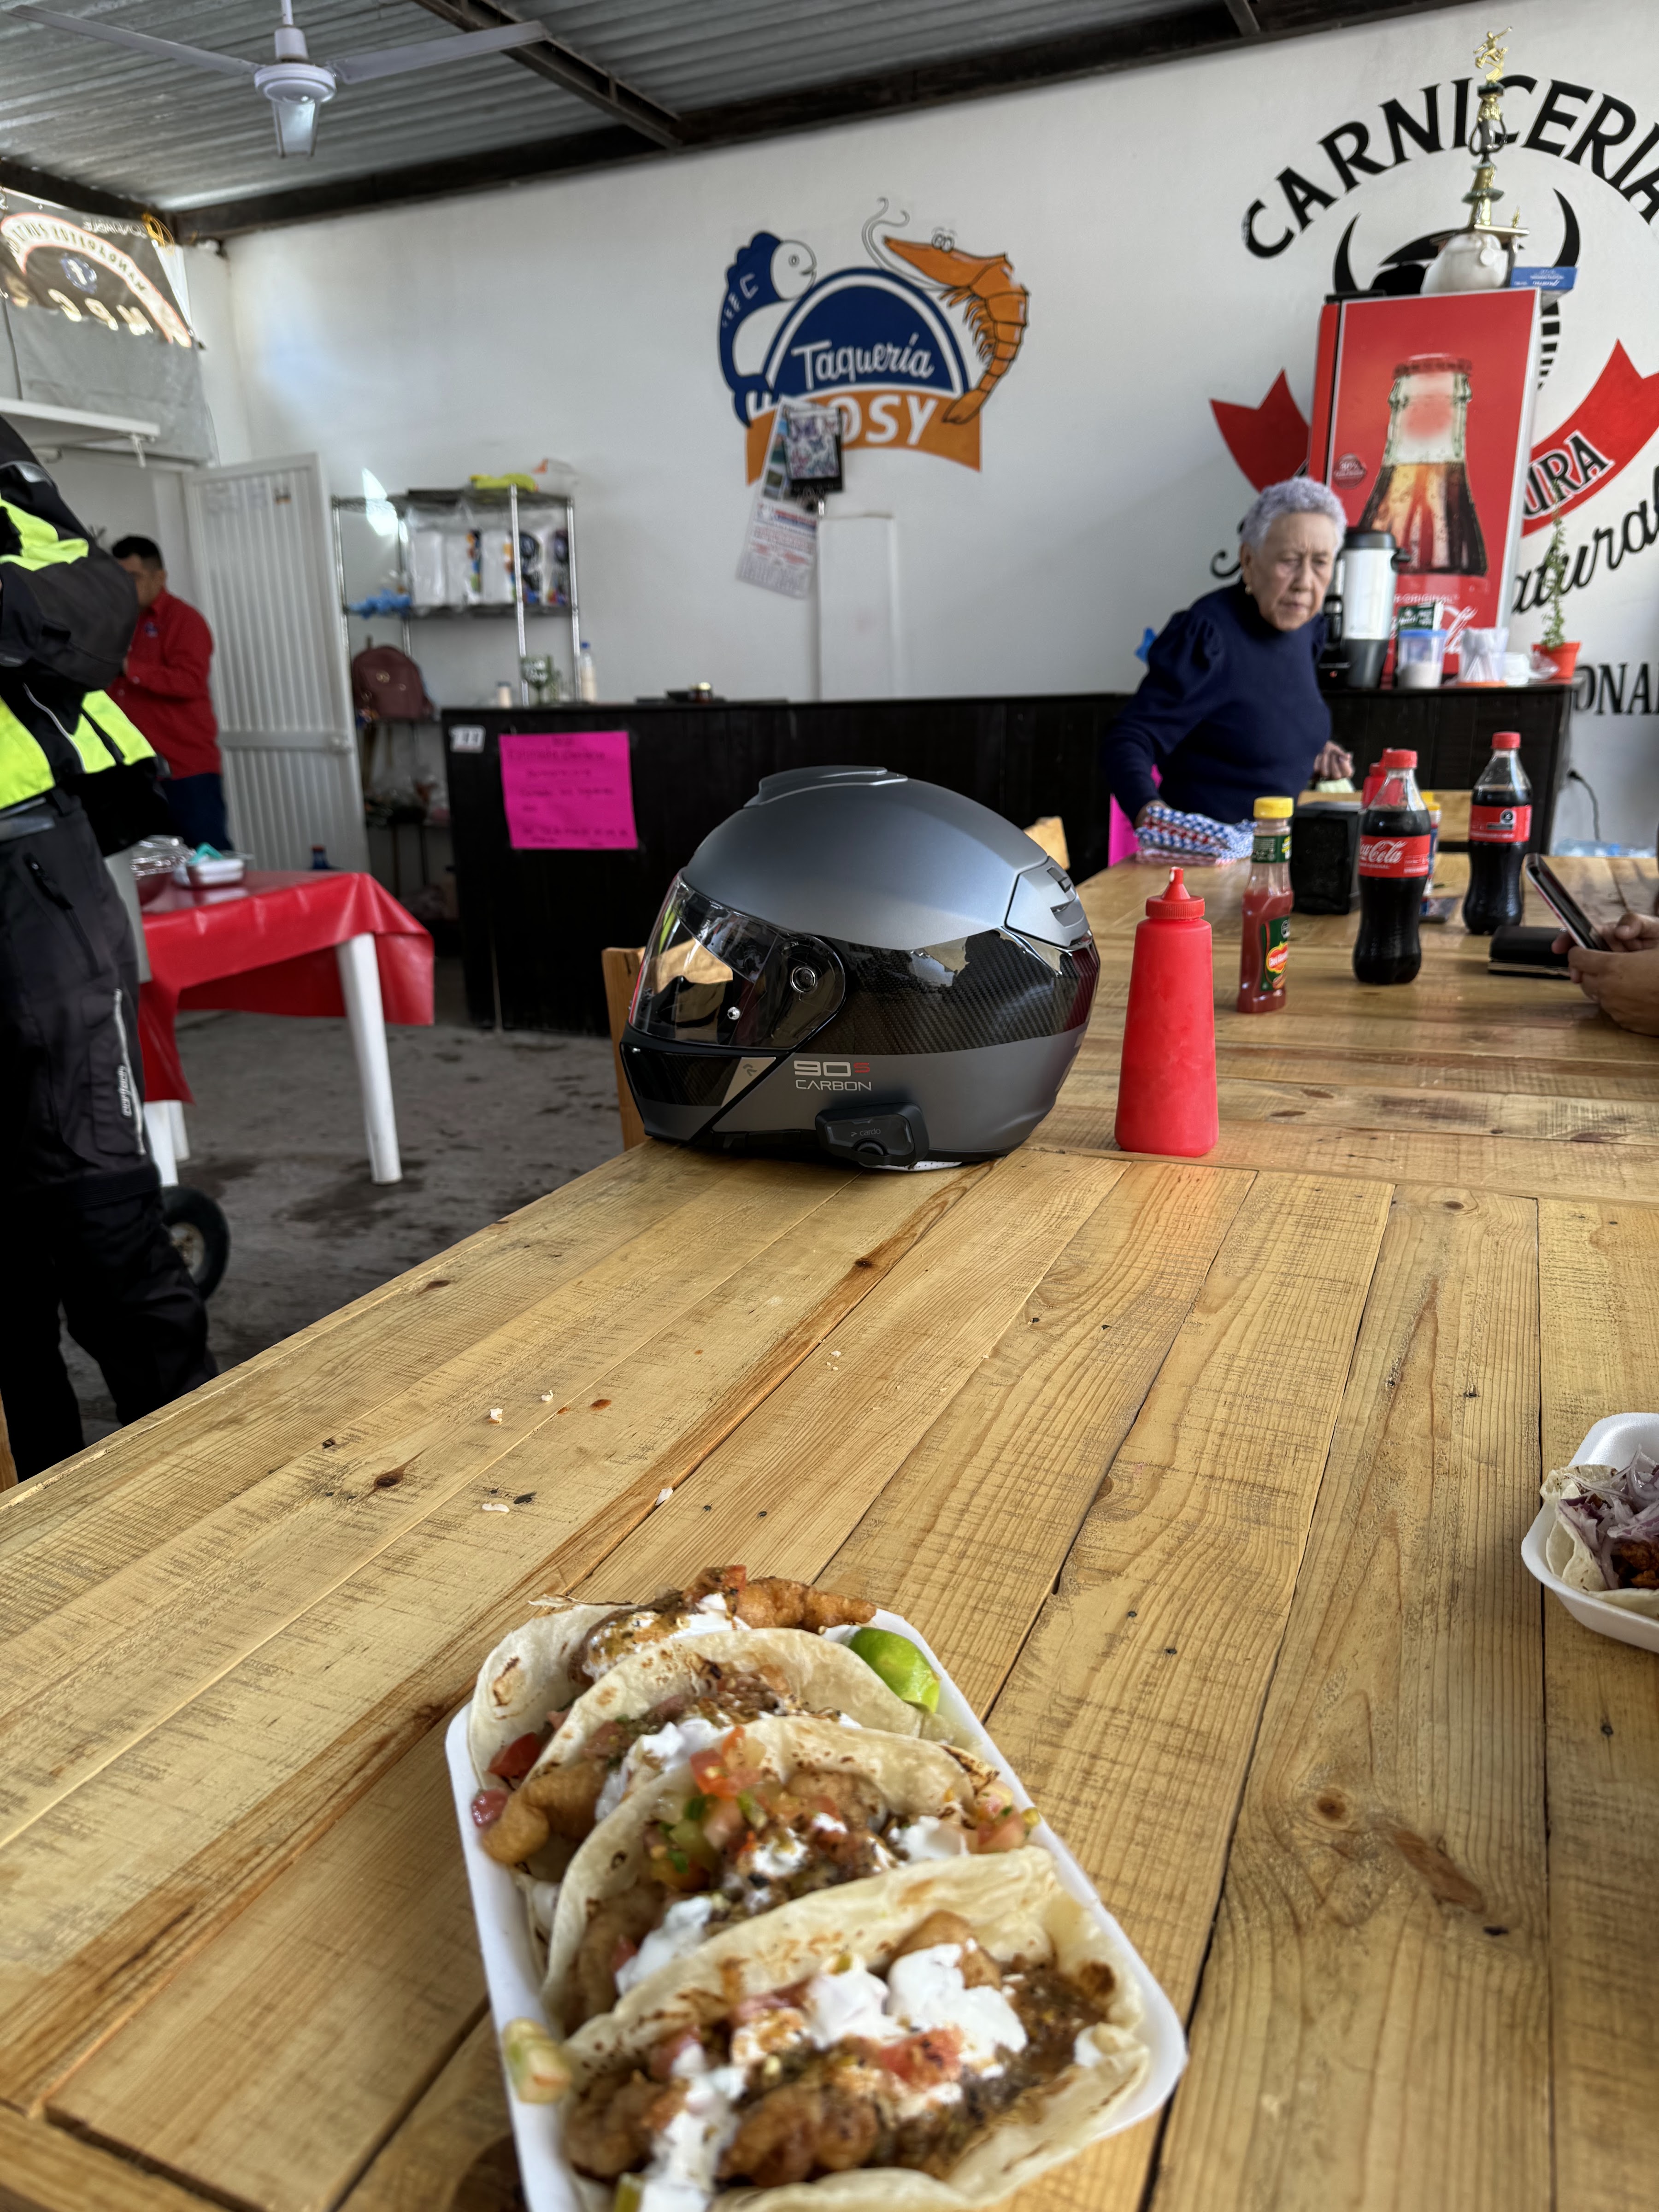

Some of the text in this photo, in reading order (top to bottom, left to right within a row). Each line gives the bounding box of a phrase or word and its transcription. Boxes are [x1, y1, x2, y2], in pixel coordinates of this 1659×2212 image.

[791, 332, 935, 390] Taquería
[828, 394, 939, 446] OSY
[1523, 429, 1616, 521] URA
[1511, 464, 1659, 614] atural
[1573, 661, 1659, 715] ONA
[795, 1079, 872, 1091] CARBON
[859, 1128, 881, 1136] cardo
